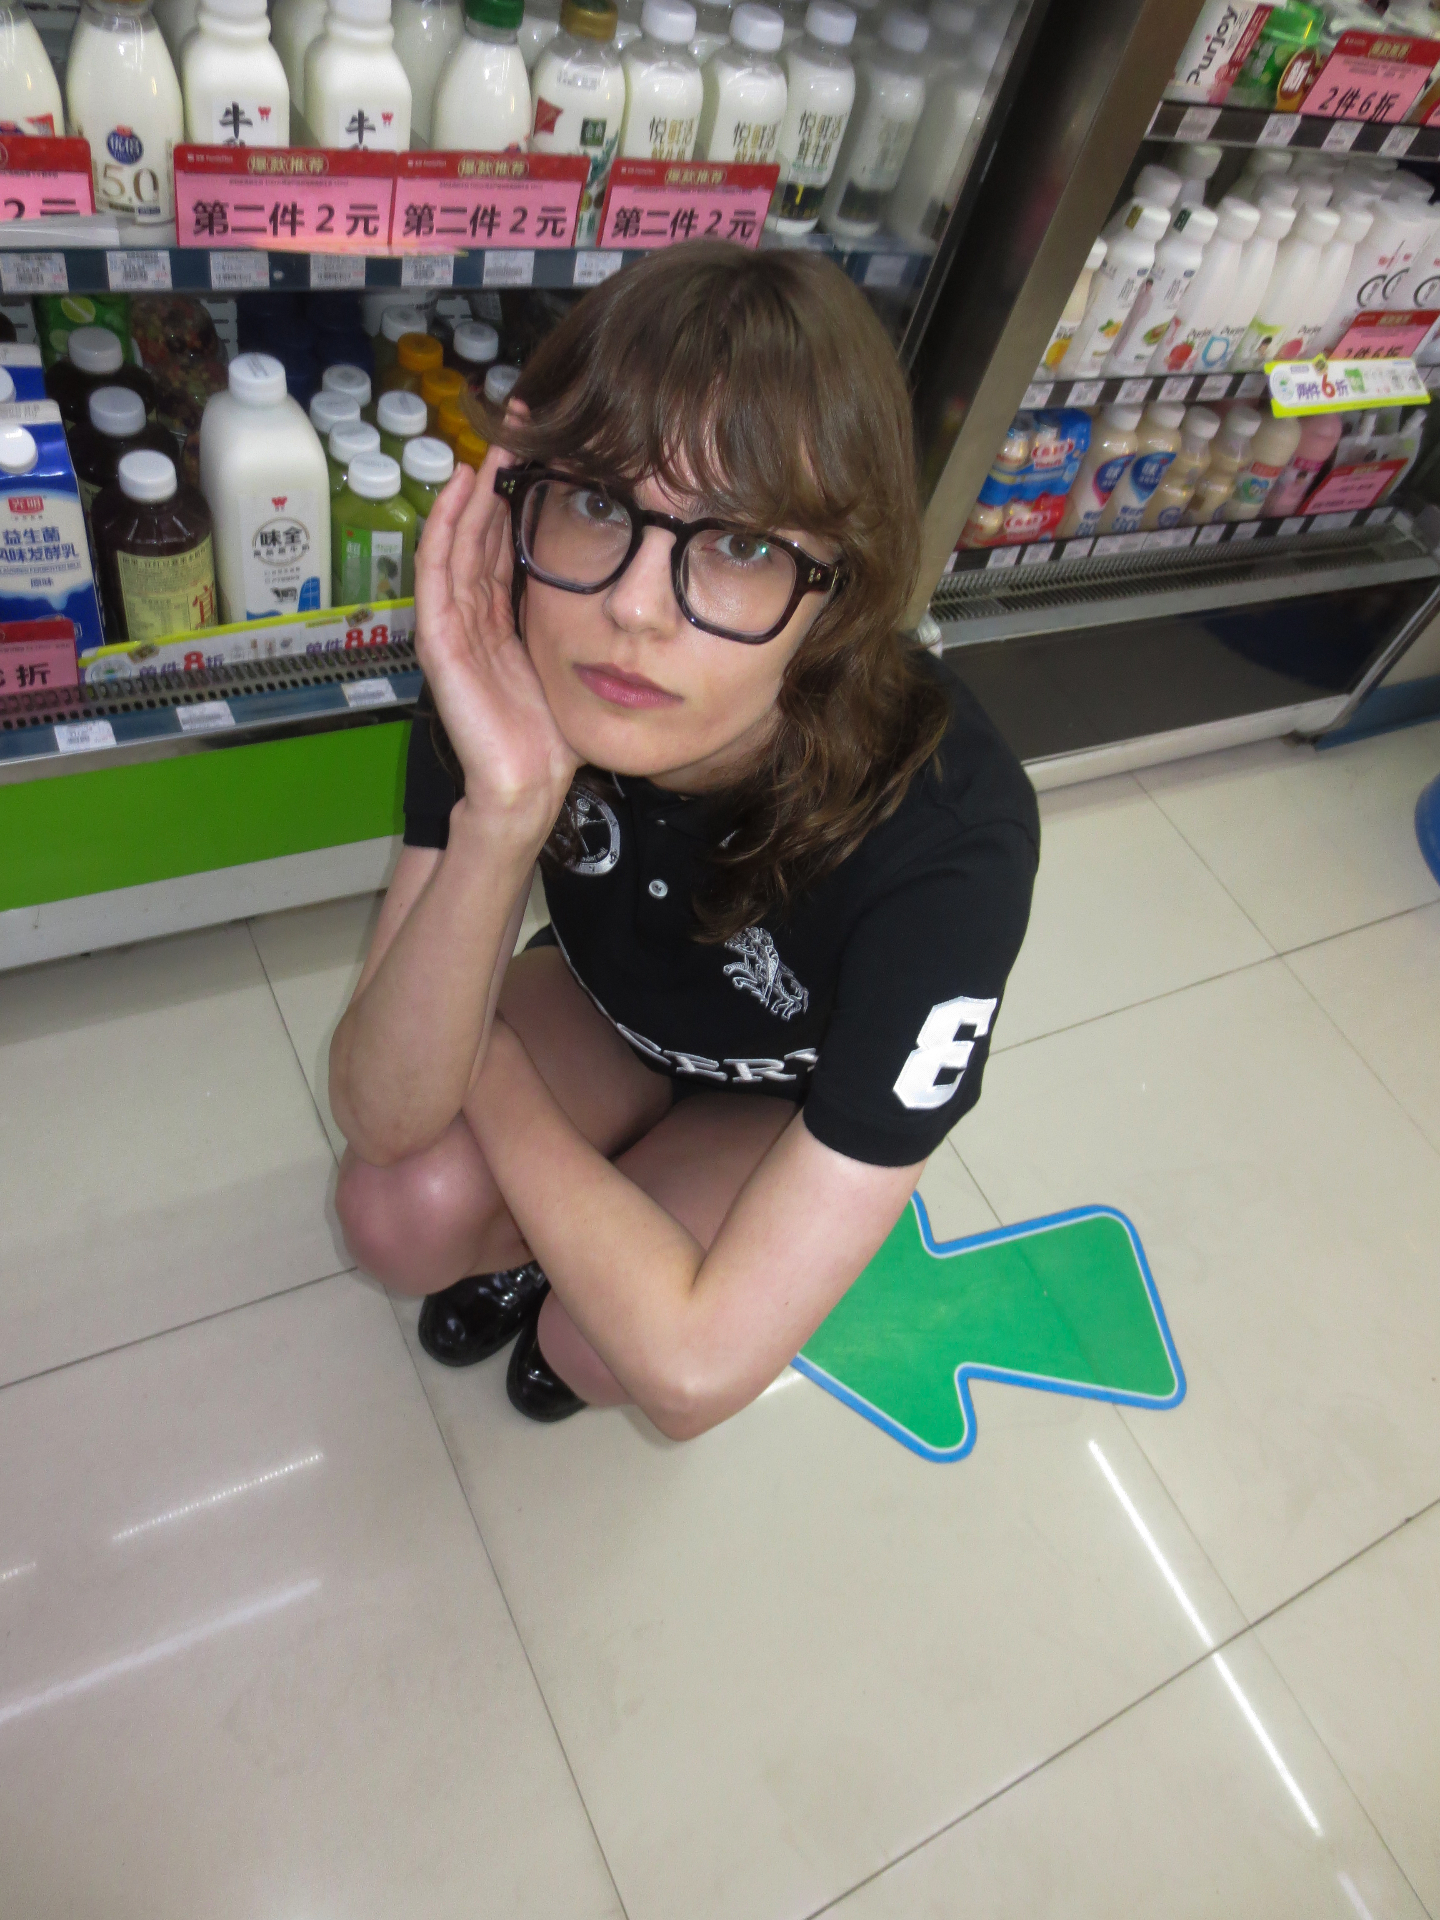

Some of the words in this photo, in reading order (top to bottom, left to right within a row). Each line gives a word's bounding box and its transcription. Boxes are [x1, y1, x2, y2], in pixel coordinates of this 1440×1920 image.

[1318, 86, 1400, 122] 2件6折
[3, 526, 60, 545] 益生菌
[260, 527, 302, 547] 味全
